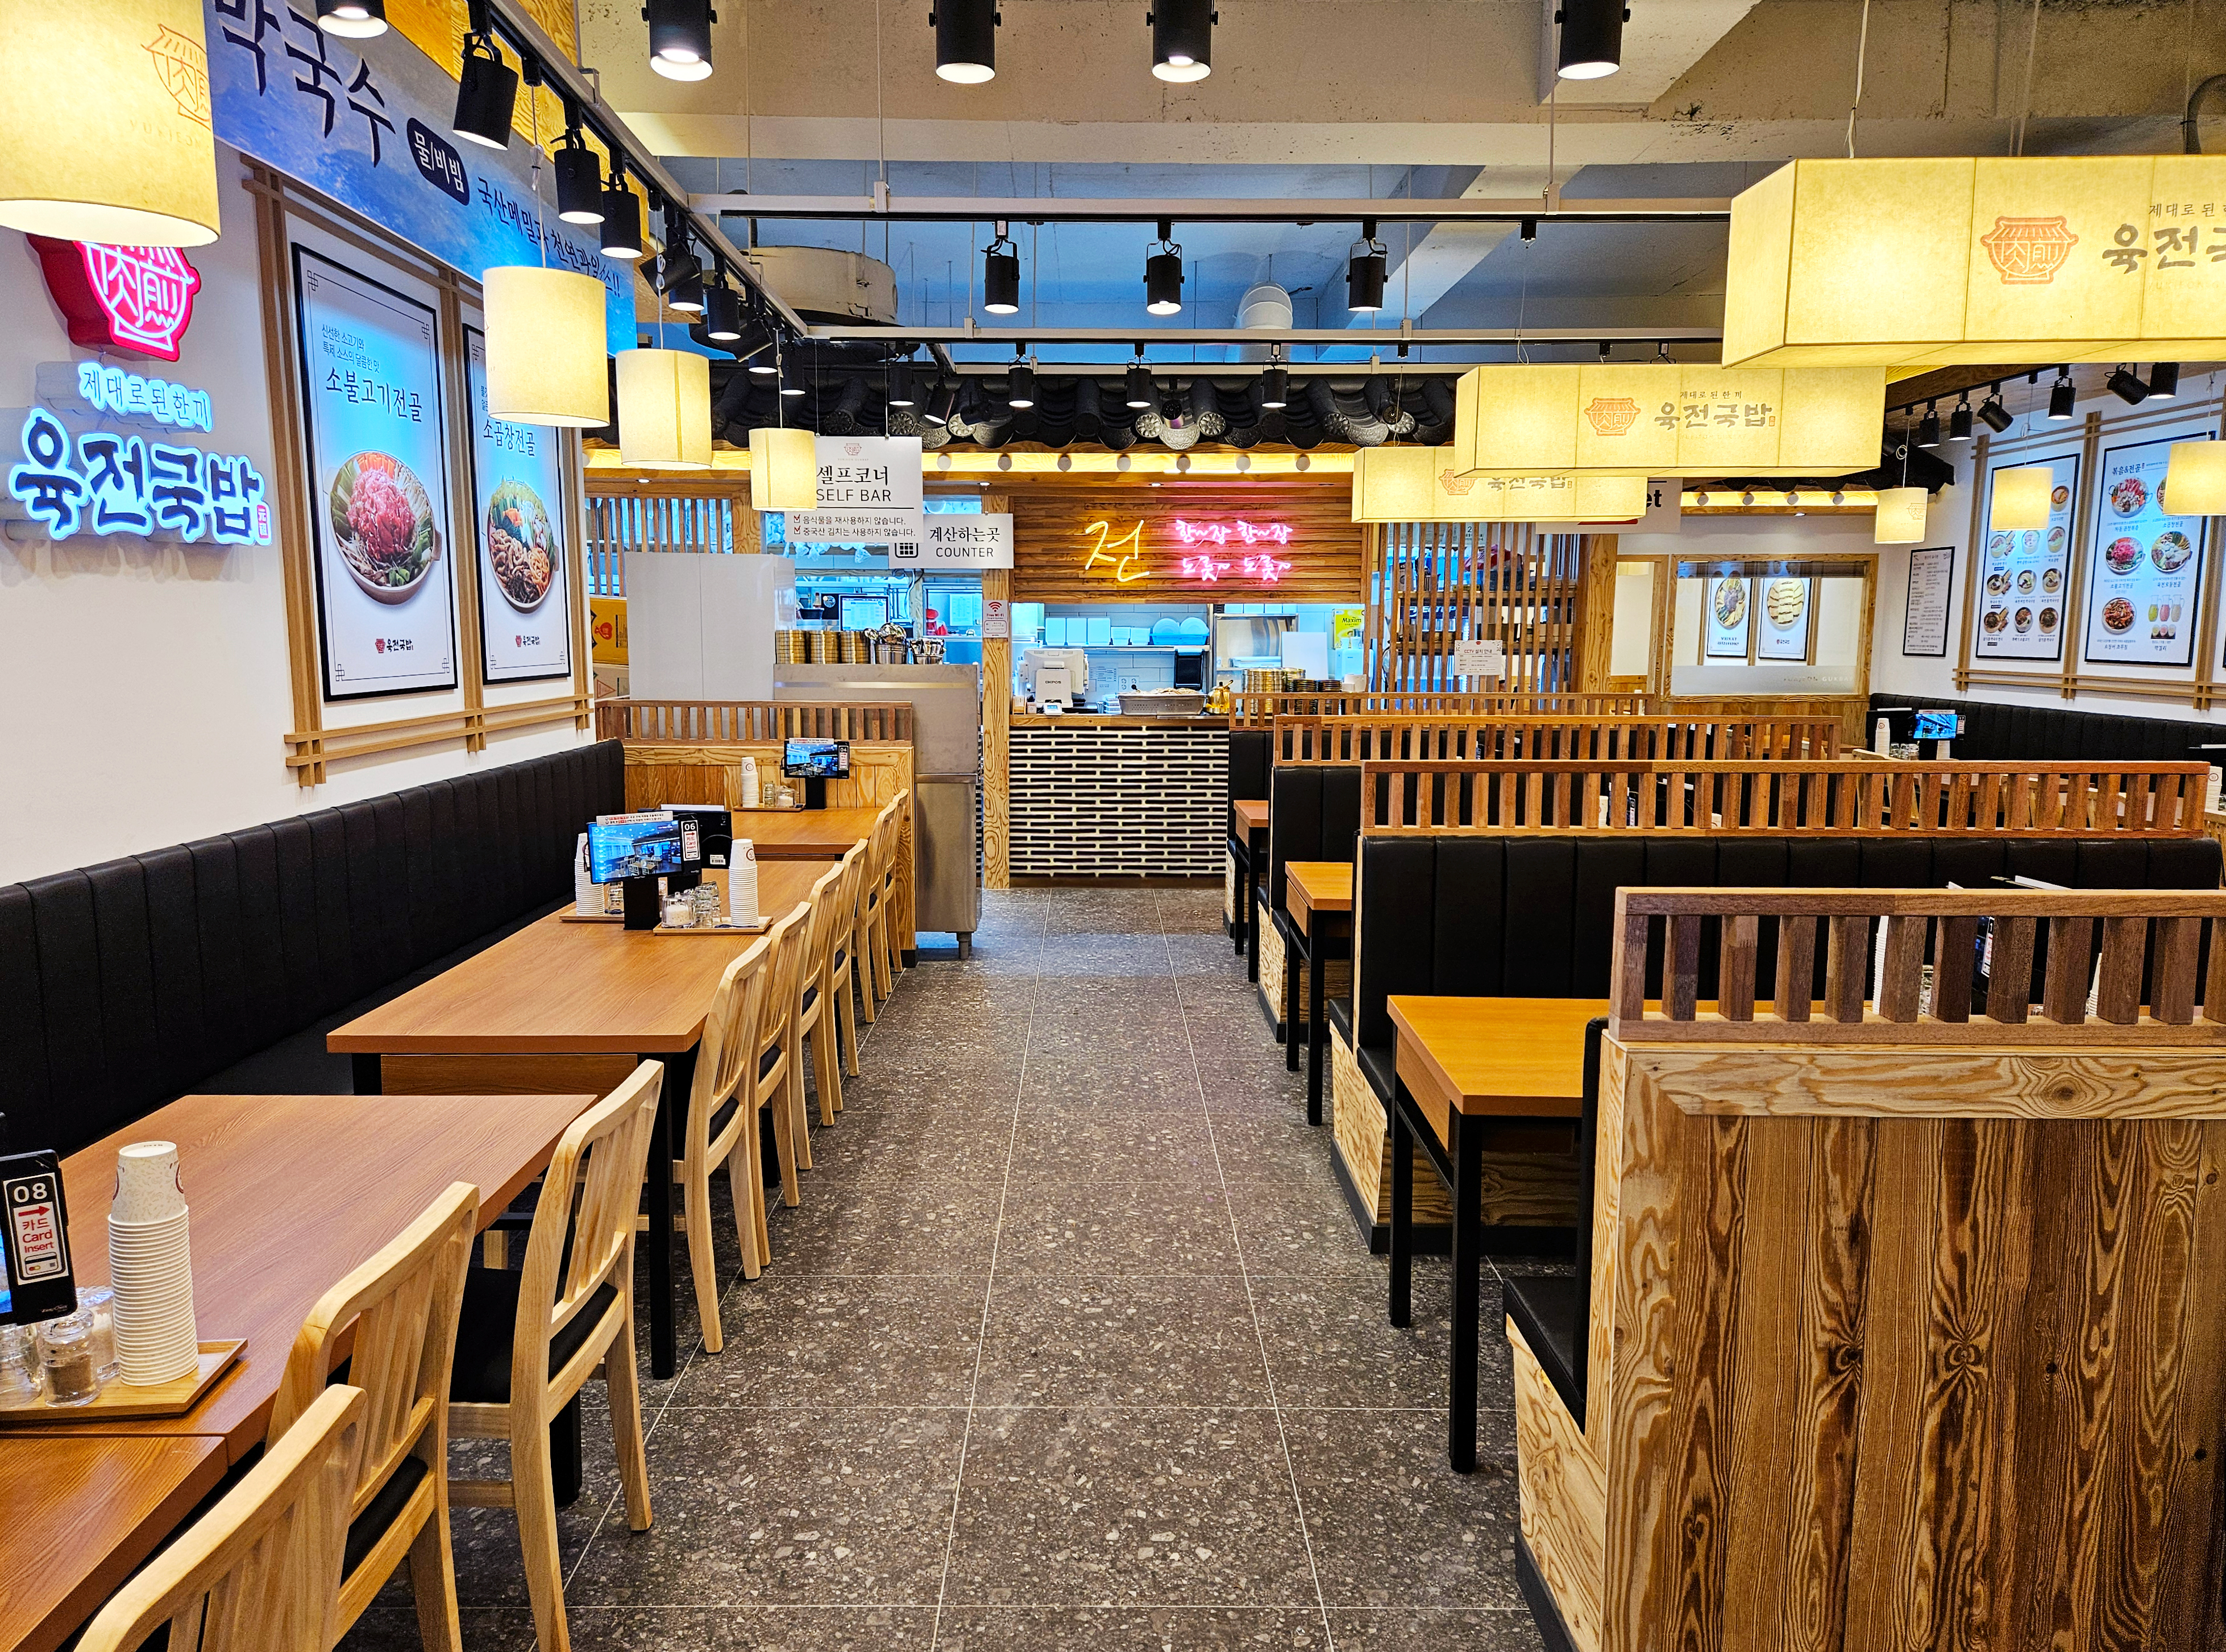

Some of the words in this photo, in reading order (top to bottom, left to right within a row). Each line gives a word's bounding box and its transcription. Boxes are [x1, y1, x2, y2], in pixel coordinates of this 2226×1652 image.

[414, 130, 465, 193] 물/비빔
[322, 324, 340, 343] 신선한
[342, 332, 364, 352] 소고기와
[323, 341, 335, 358] 특제
[337, 347, 354, 364] 소스의
[355, 354, 372, 371] 달콤한
[373, 360, 380, 373] 맛
[326, 366, 422, 422] 소불고기전골
[1654, 402, 1772, 430] 육전국밥
[483, 419, 535, 456] 소곱창전골
[15, 416, 260, 538] 육전국밥
[816, 465, 888, 485] 셀프코너
[816, 488, 854, 501] SELF
[861, 489, 891, 502] BAR
[803, 516, 832, 525] 음식물을
[834, 516, 872, 525] 재사용하지
[874, 517, 906, 526] 않습니다.
[803, 527, 825, 536] 중국산
[828, 528, 850, 537] 김치는
[852, 528, 882, 537] 사용하지
[883, 528, 916, 537] 않습니다.
[929, 526, 1001, 543] 계산하는곳
[936, 547, 994, 558] COUNTER
[1085, 518, 1151, 583] 전
[387, 638, 412, 653] 육전국밥
[522, 635, 541, 647] 육전국밥
[13, 1182, 48, 1203] 08
[22, 1218, 50, 1231] 카드
[22, 1228, 53, 1244] Card
[24, 1241, 55, 1253] Insert
